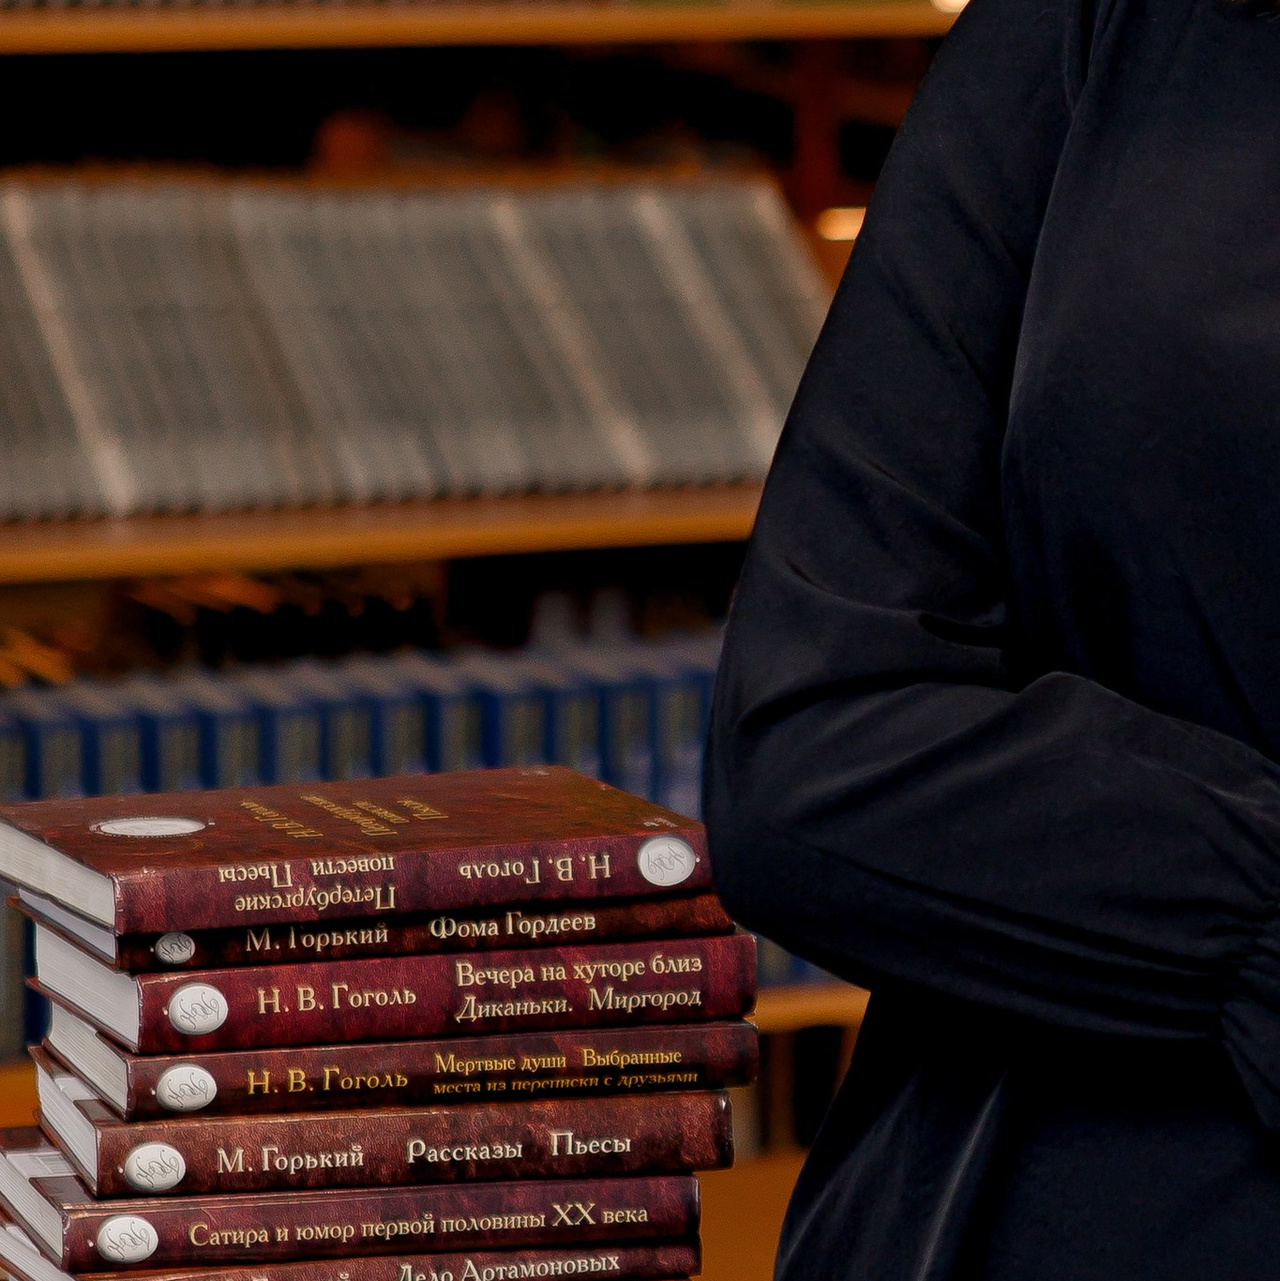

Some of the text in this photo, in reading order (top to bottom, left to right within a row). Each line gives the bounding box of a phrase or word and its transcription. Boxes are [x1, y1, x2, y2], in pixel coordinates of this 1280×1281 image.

[218, 856, 395, 889] повести Пьесы
[459, 859, 541, 885] Гоголь
[548, 857, 574, 882] В.
[581, 854, 612, 880] Н.
[235, 885, 396, 911] Петербургские
[246, 922, 389, 952] М. Горький
[429, 911, 596, 940] Фома Гордеев
[456, 954, 703, 989] Вечера на хуторе близ
[257, 987, 290, 1015] Н.
[297, 986, 325, 1012] В.
[332, 982, 417, 1010] Гоголь
[456, 985, 702, 1023] Диканьки. Миргород
[434, 1048, 682, 1076] Мертвые души Выбранные
[248, 1066, 408, 1095] Н. В. Гоголь
[434, 1072, 698, 1094] места из переписки с друзьями
[217, 1147, 253, 1174] М.
[261, 1142, 364, 1174] Горький
[407, 1131, 631, 1164] Рассказы Пьесы
[189, 1222, 269, 1248] Сатира
[276, 1227, 288, 1242] и
[296, 1224, 355, 1243] юмор
[361, 1212, 435, 1241] первой
[441, 1214, 546, 1233] половины
[603, 1208, 648, 1224] века
